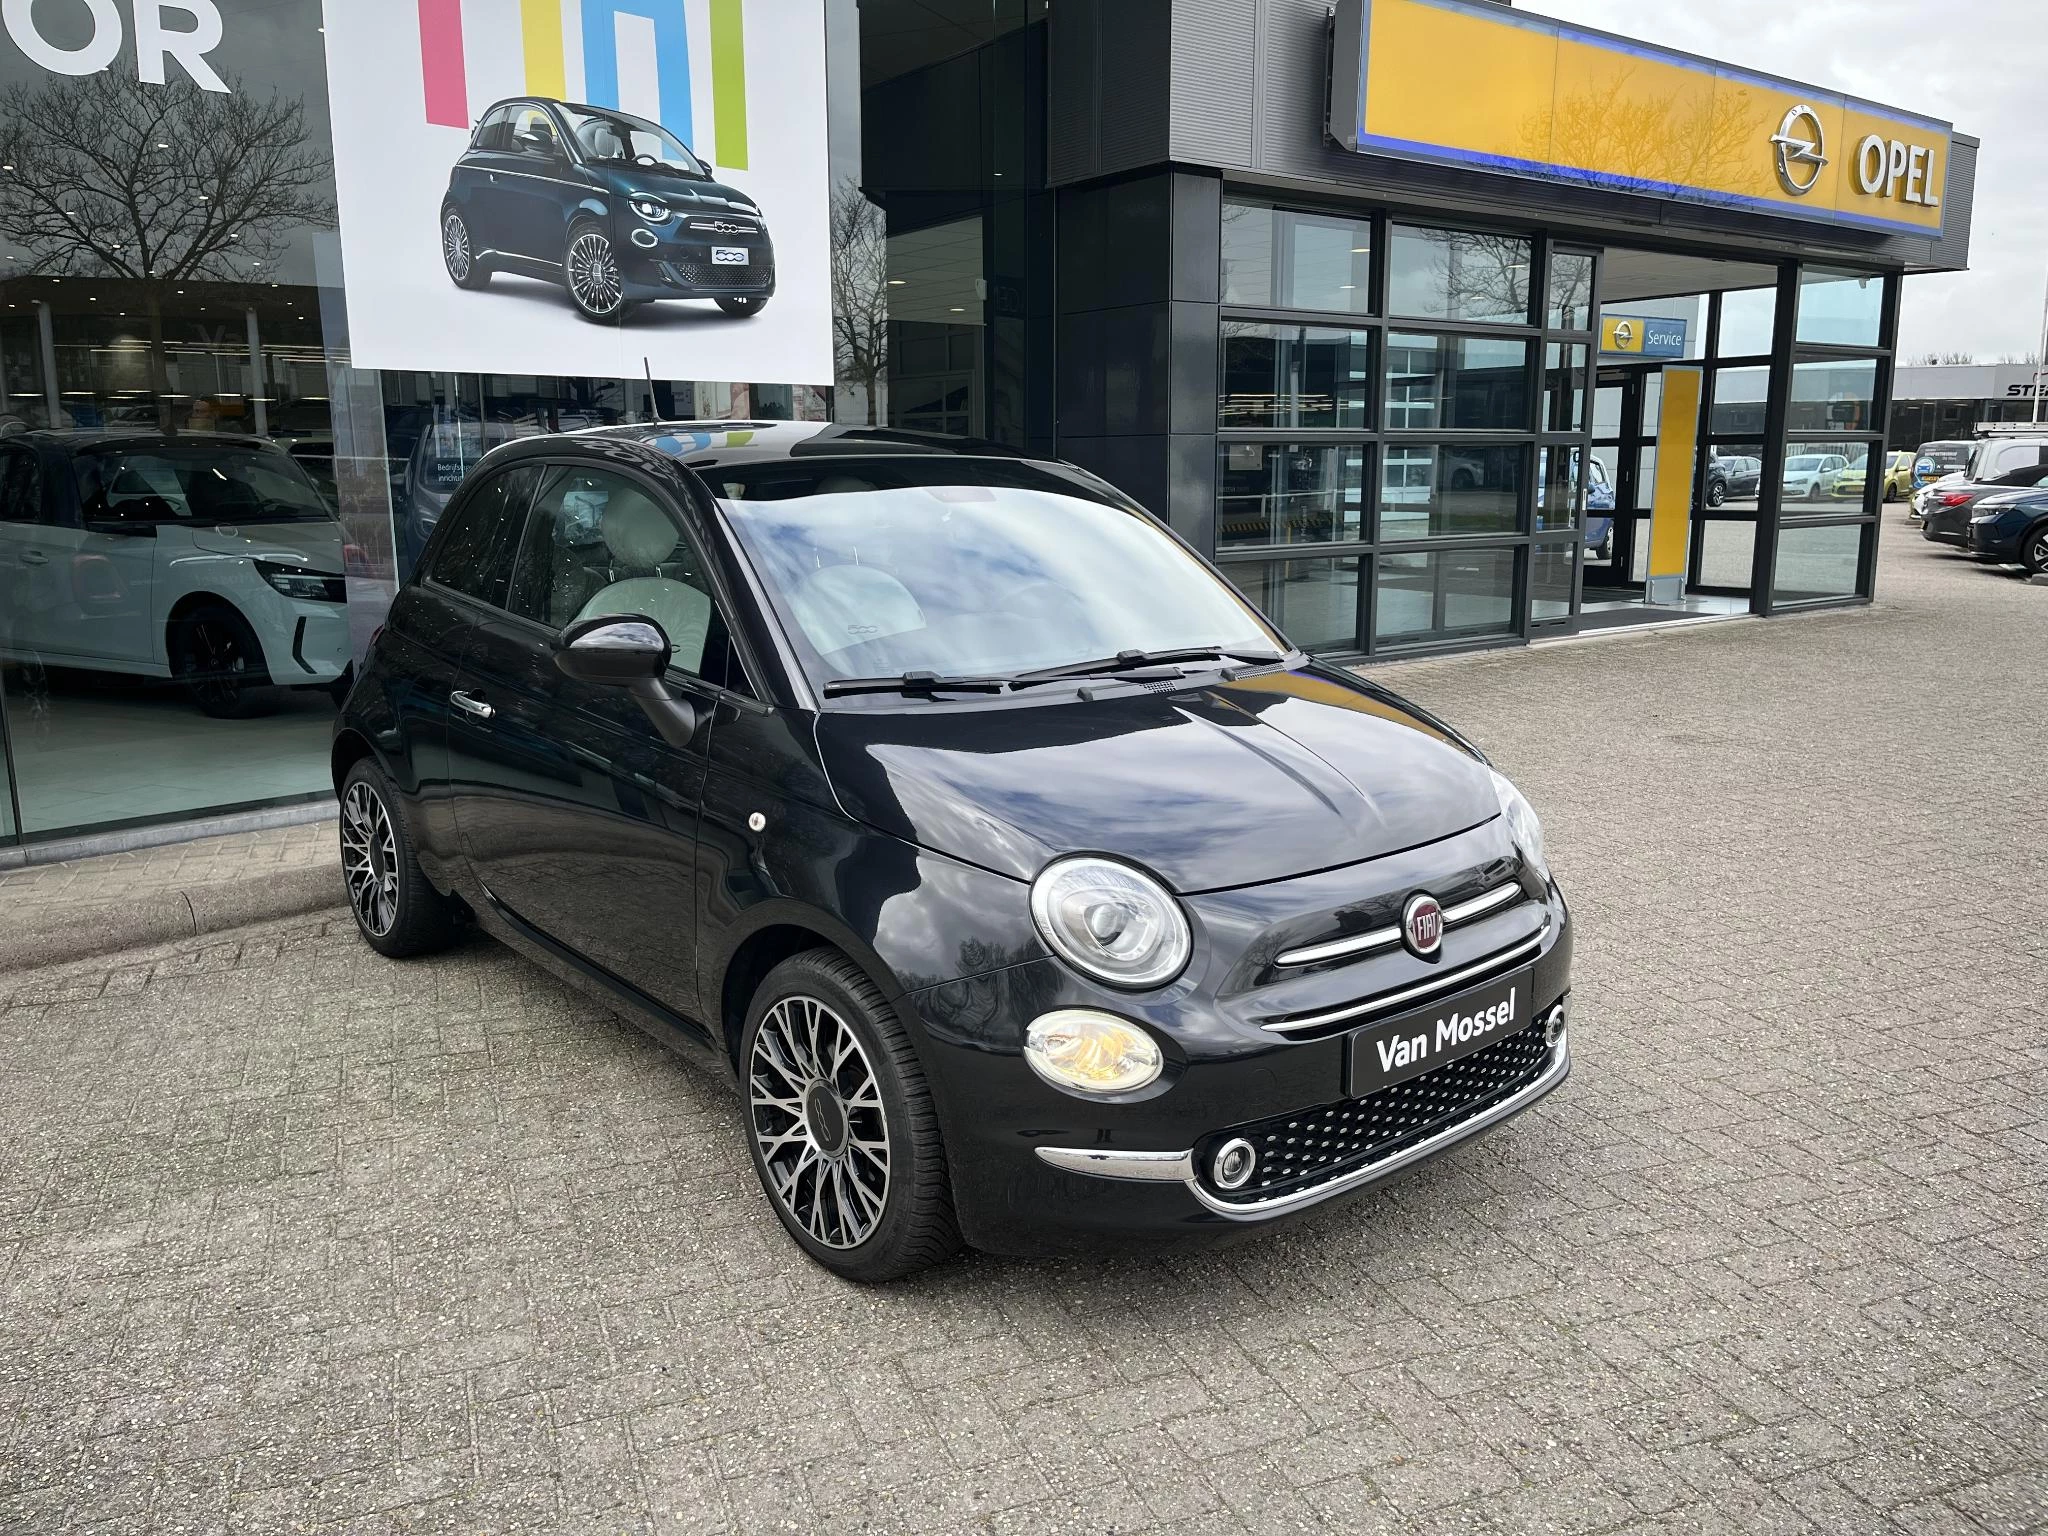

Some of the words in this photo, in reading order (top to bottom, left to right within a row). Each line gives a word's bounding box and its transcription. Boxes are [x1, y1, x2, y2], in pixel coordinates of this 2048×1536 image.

[2, 0, 232, 94] OR
[1857, 134, 1939, 207] OPEL
[714, 221, 739, 234] 500
[715, 249, 745, 262] 500
[1648, 330, 1682, 346] Service
[2006, 384, 2048, 397] STE
[1416, 911, 1437, 941] FIAT
[1376, 1033, 1428, 1073] Van
[1435, 986, 1516, 1053] Mossel
